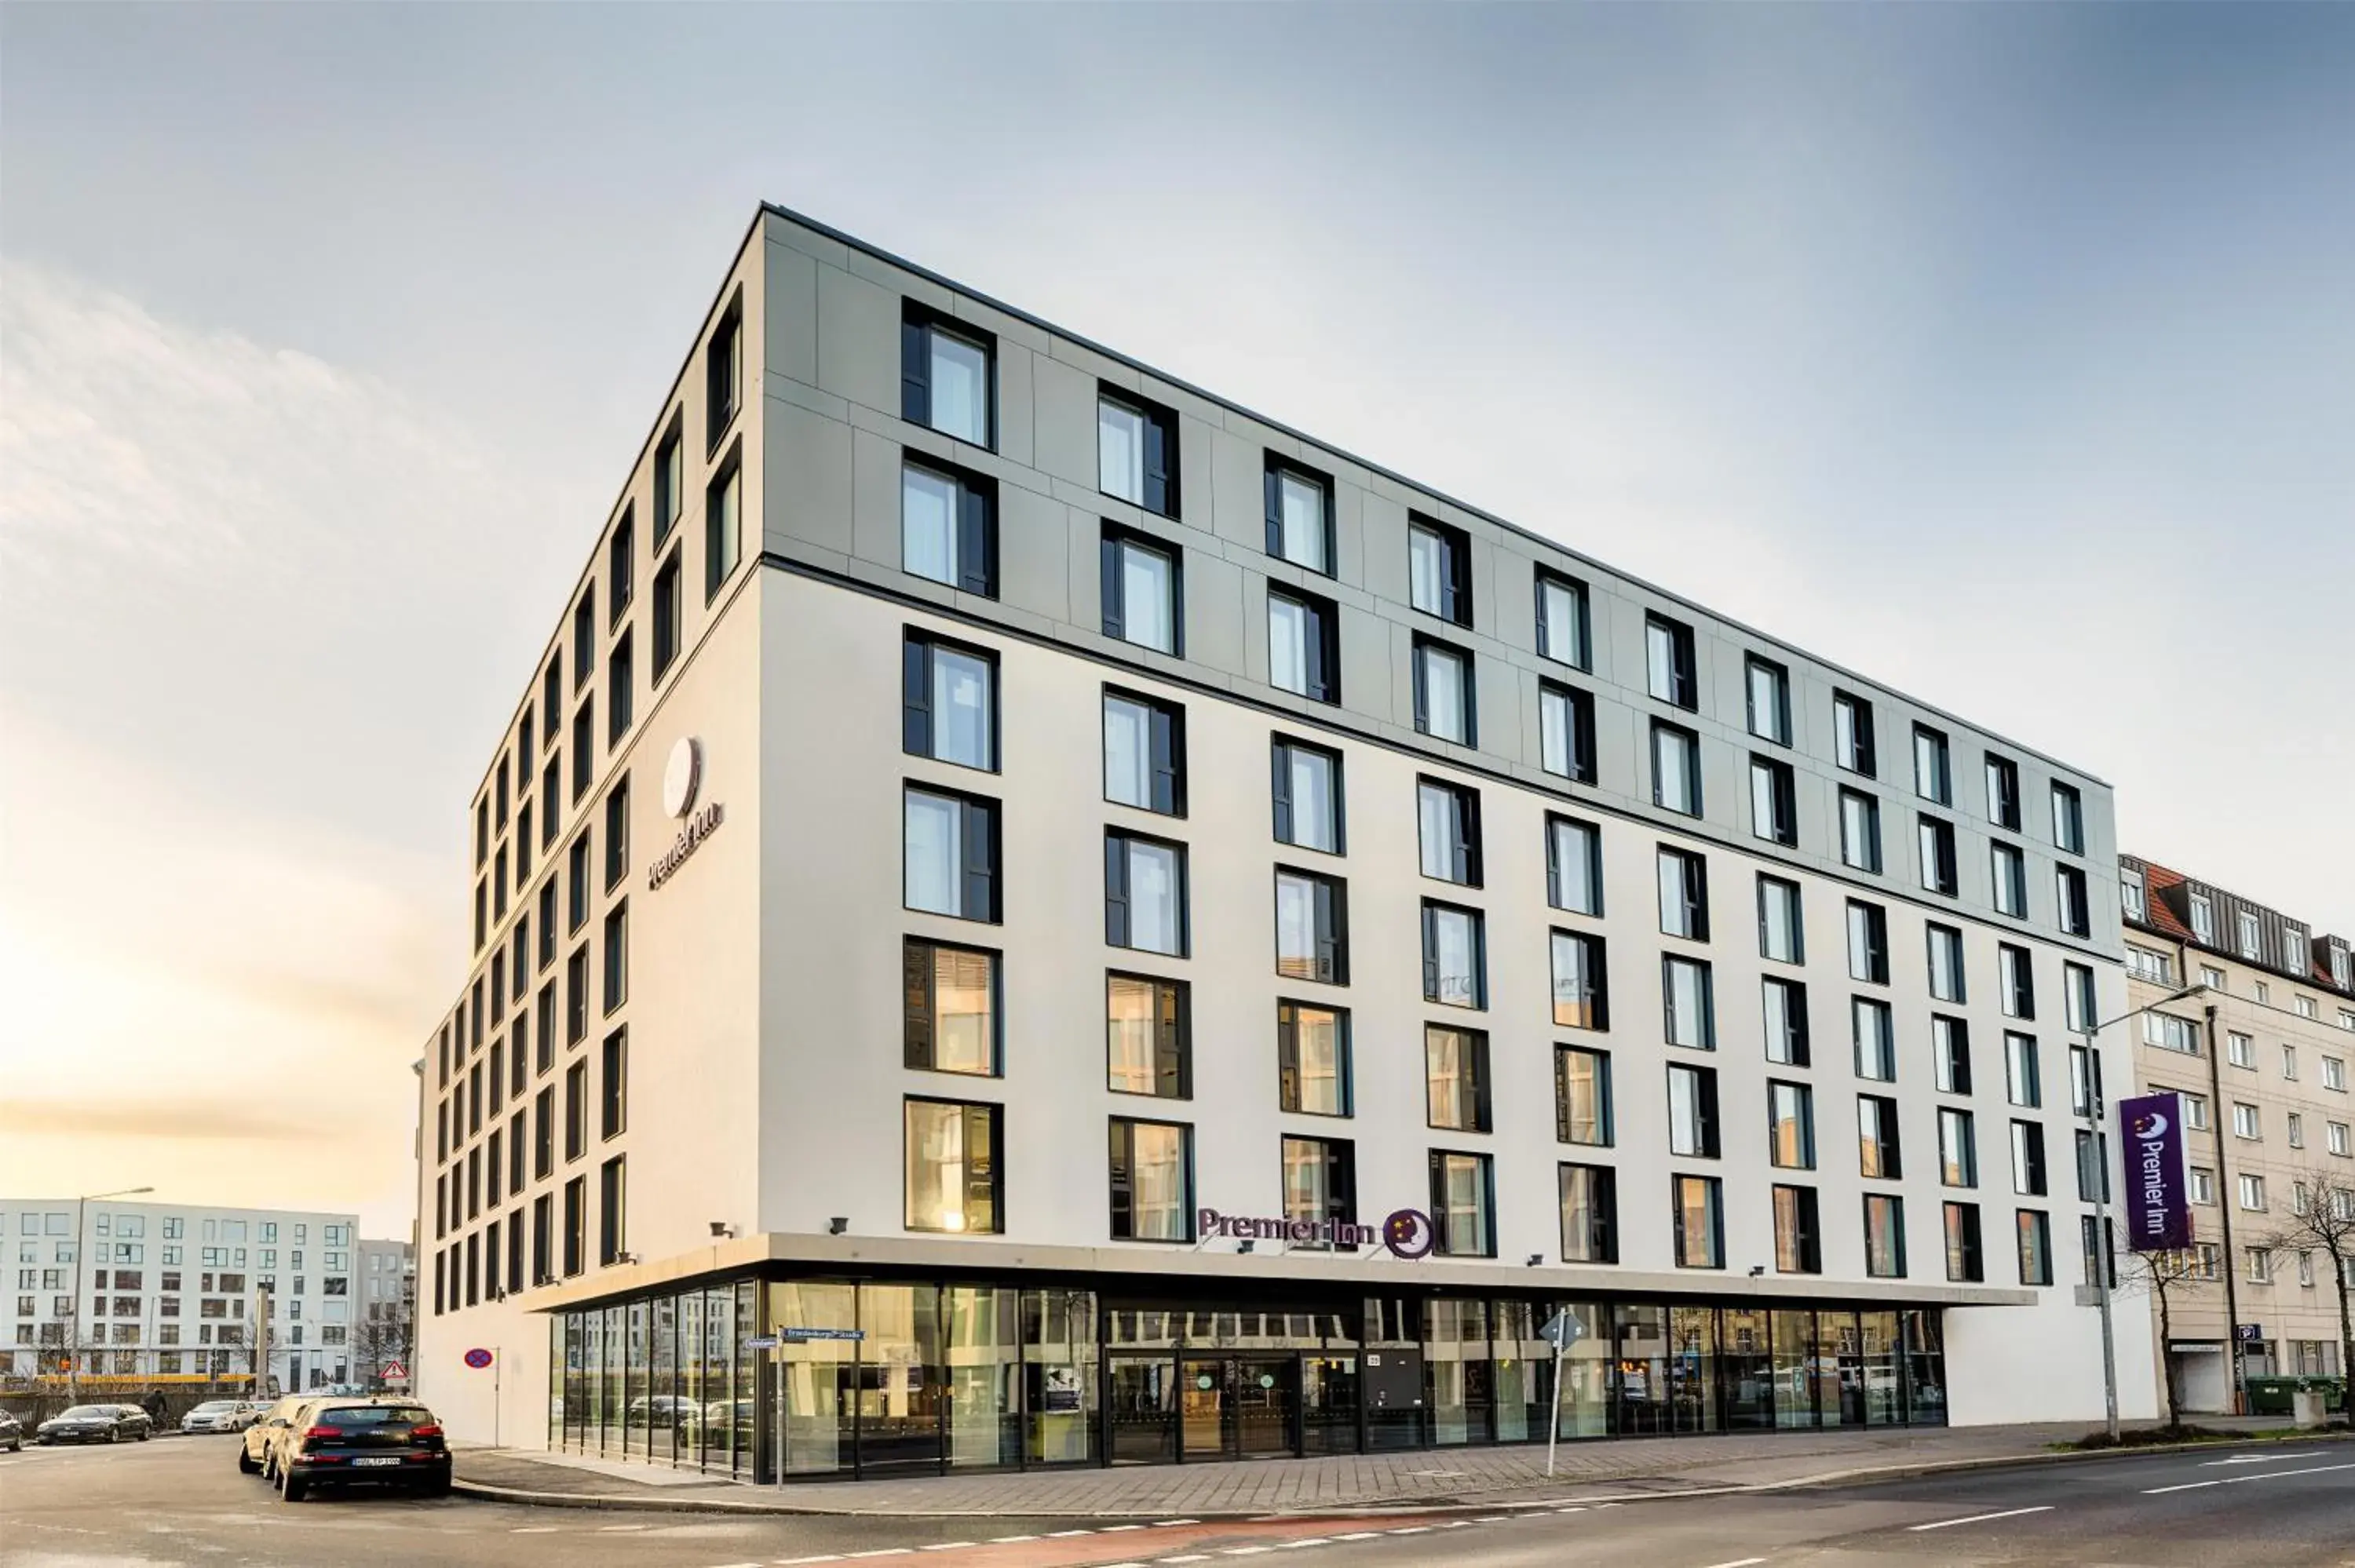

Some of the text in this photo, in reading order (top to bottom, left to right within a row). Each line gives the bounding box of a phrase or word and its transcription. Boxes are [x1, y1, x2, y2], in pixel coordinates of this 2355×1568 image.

[2142, 1140, 2169, 1234] Premier Inn
[1198, 1209, 1375, 1244] Premier Inn
